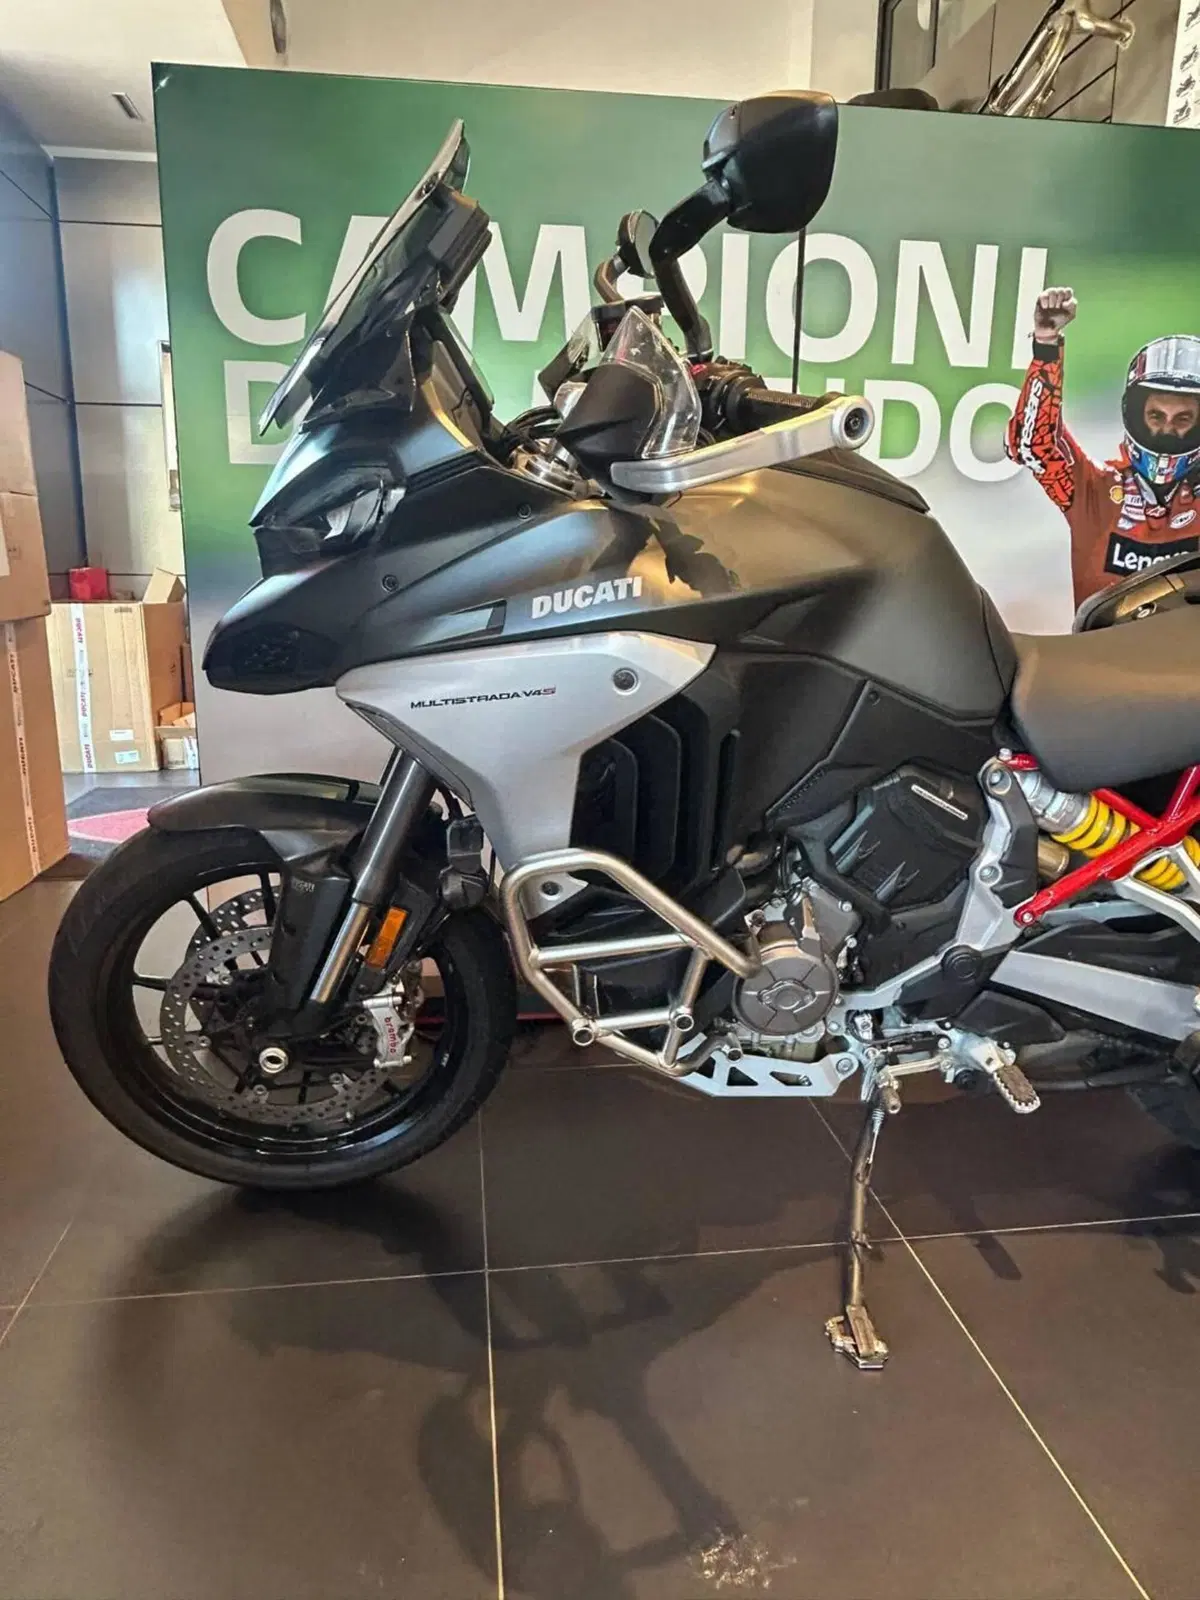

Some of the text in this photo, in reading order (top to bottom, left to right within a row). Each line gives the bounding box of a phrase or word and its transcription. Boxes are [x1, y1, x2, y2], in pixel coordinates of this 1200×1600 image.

[1112, 543, 1189, 571] Len
[531, 576, 643, 619] DUCATI
[410, 687, 556, 709] MULTISTRADA V4S
[384, 1016, 397, 1054] brembo
